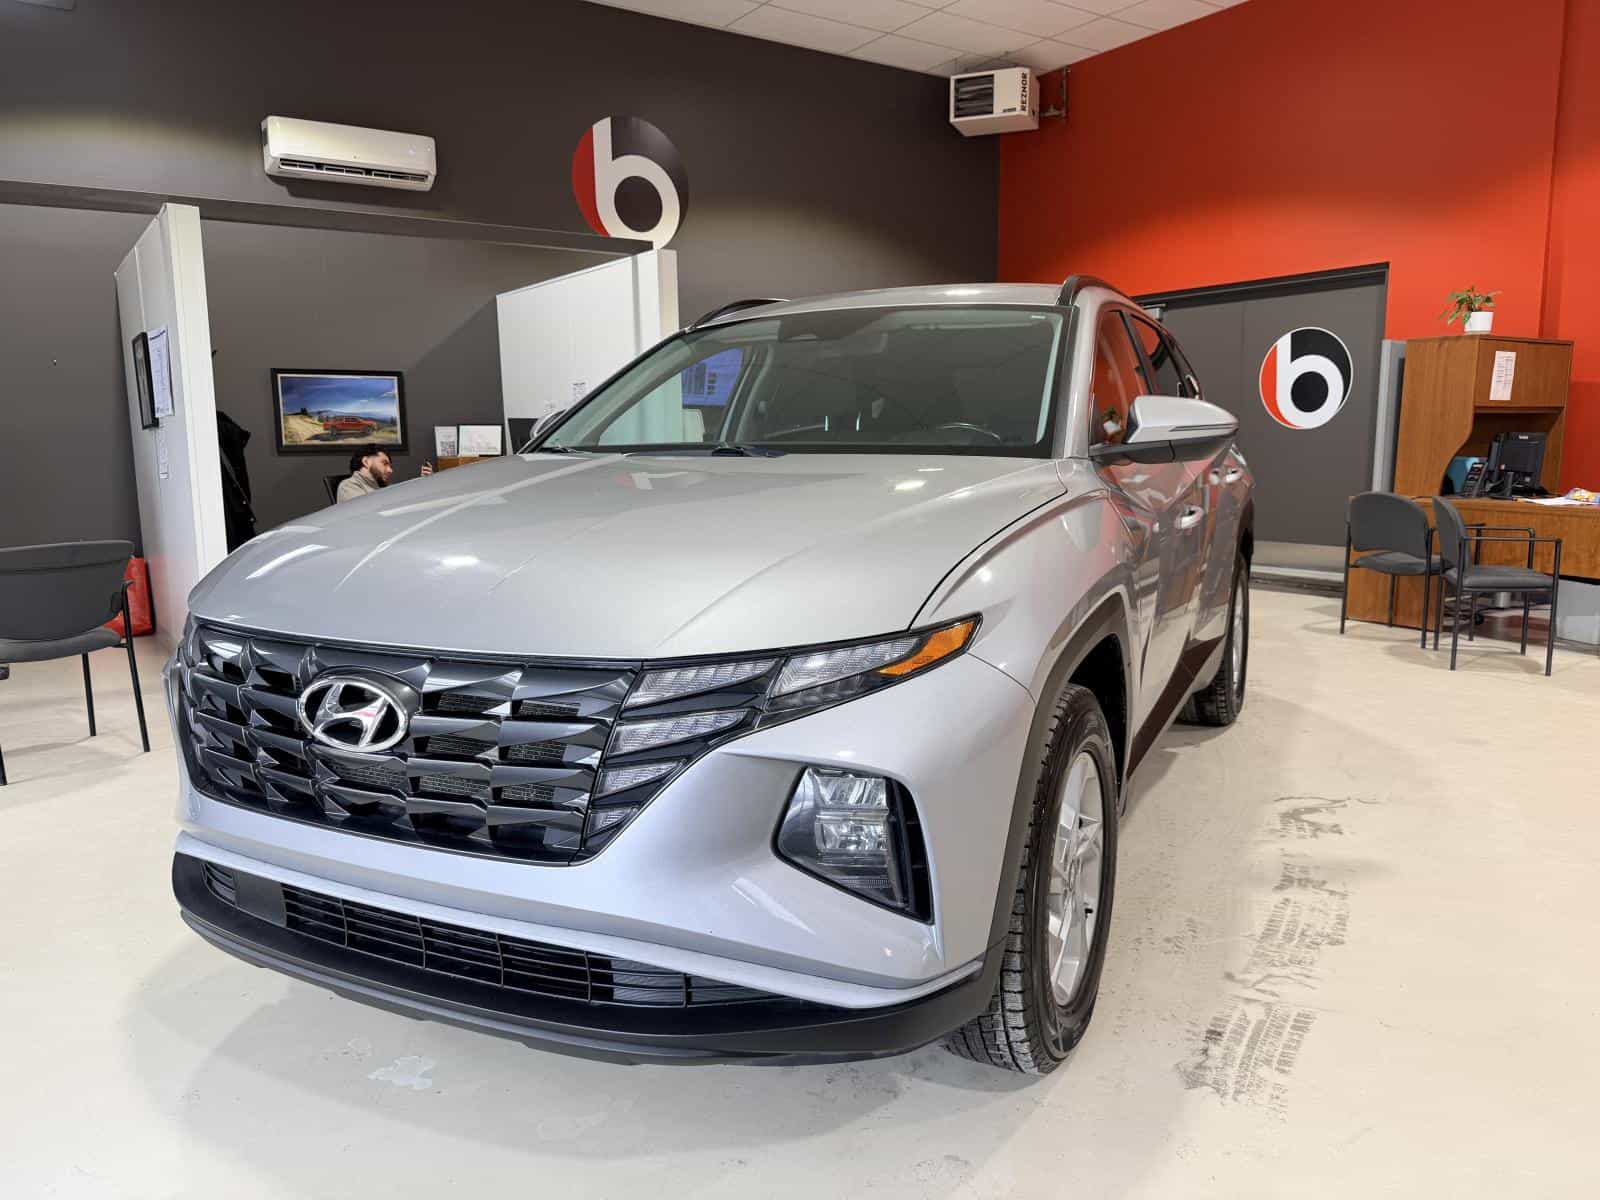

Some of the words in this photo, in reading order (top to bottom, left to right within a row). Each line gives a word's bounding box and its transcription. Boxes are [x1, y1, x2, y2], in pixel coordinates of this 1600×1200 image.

[1020, 72, 1028, 112] REZNOR
[592, 116, 680, 249] b
[1275, 331, 1344, 429] b
